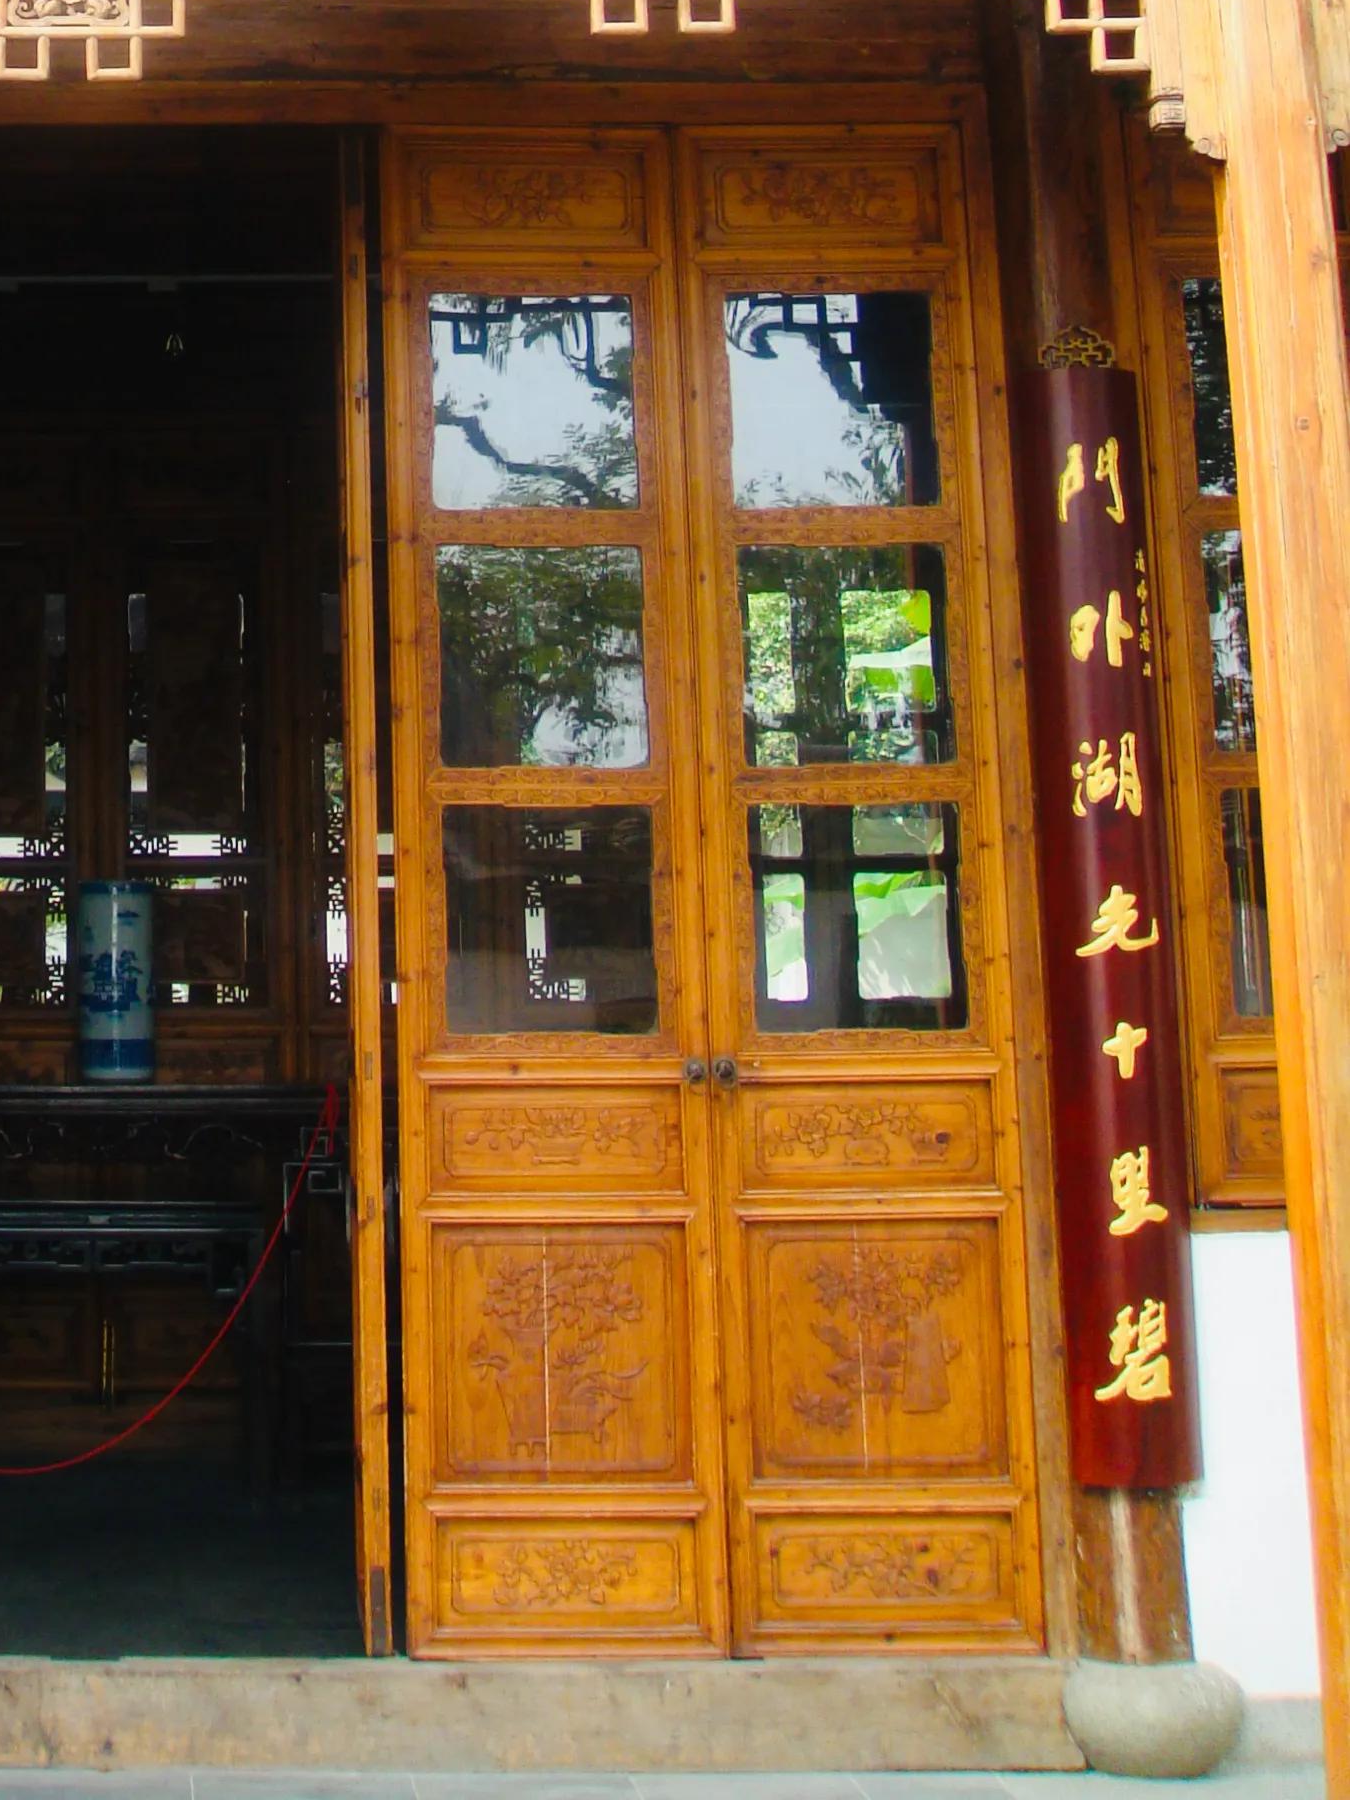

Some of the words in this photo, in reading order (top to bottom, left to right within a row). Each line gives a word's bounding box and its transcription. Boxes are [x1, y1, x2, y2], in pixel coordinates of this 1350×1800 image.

[1059, 436, 1172, 1402] 門外湖光十里碧
